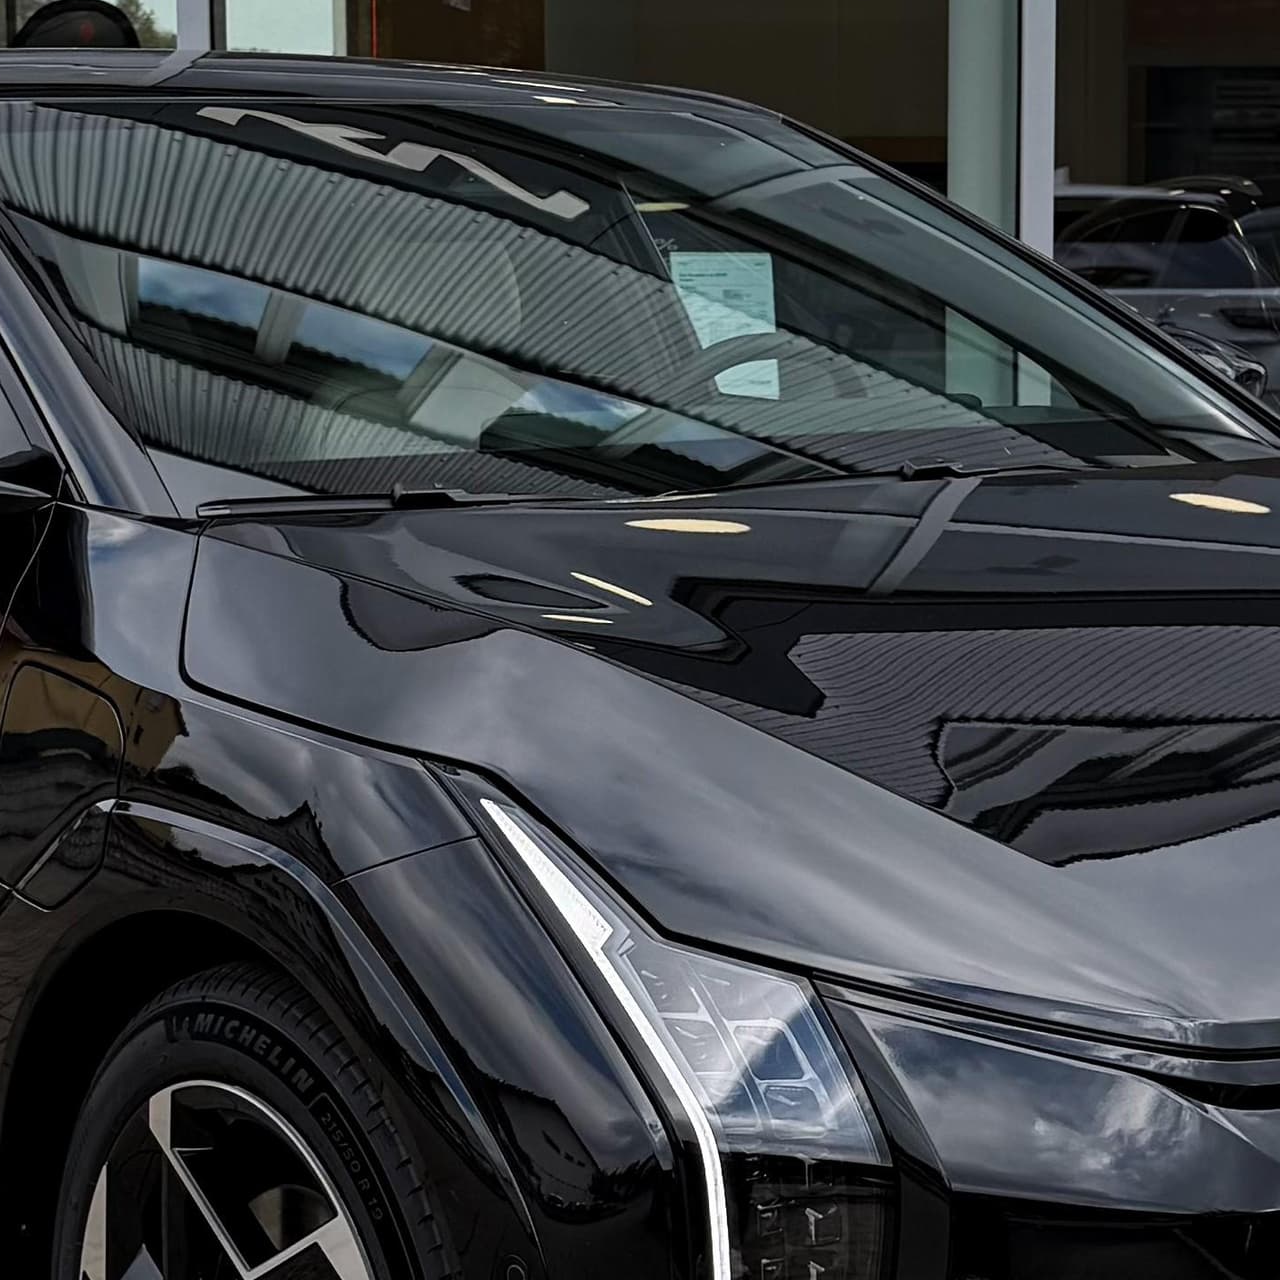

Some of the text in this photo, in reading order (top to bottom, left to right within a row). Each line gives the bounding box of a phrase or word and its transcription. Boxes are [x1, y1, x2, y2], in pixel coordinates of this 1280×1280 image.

[193, 1012, 315, 1094] MICHELIN
[321, 1112, 384, 1221] 215/50 R 19
